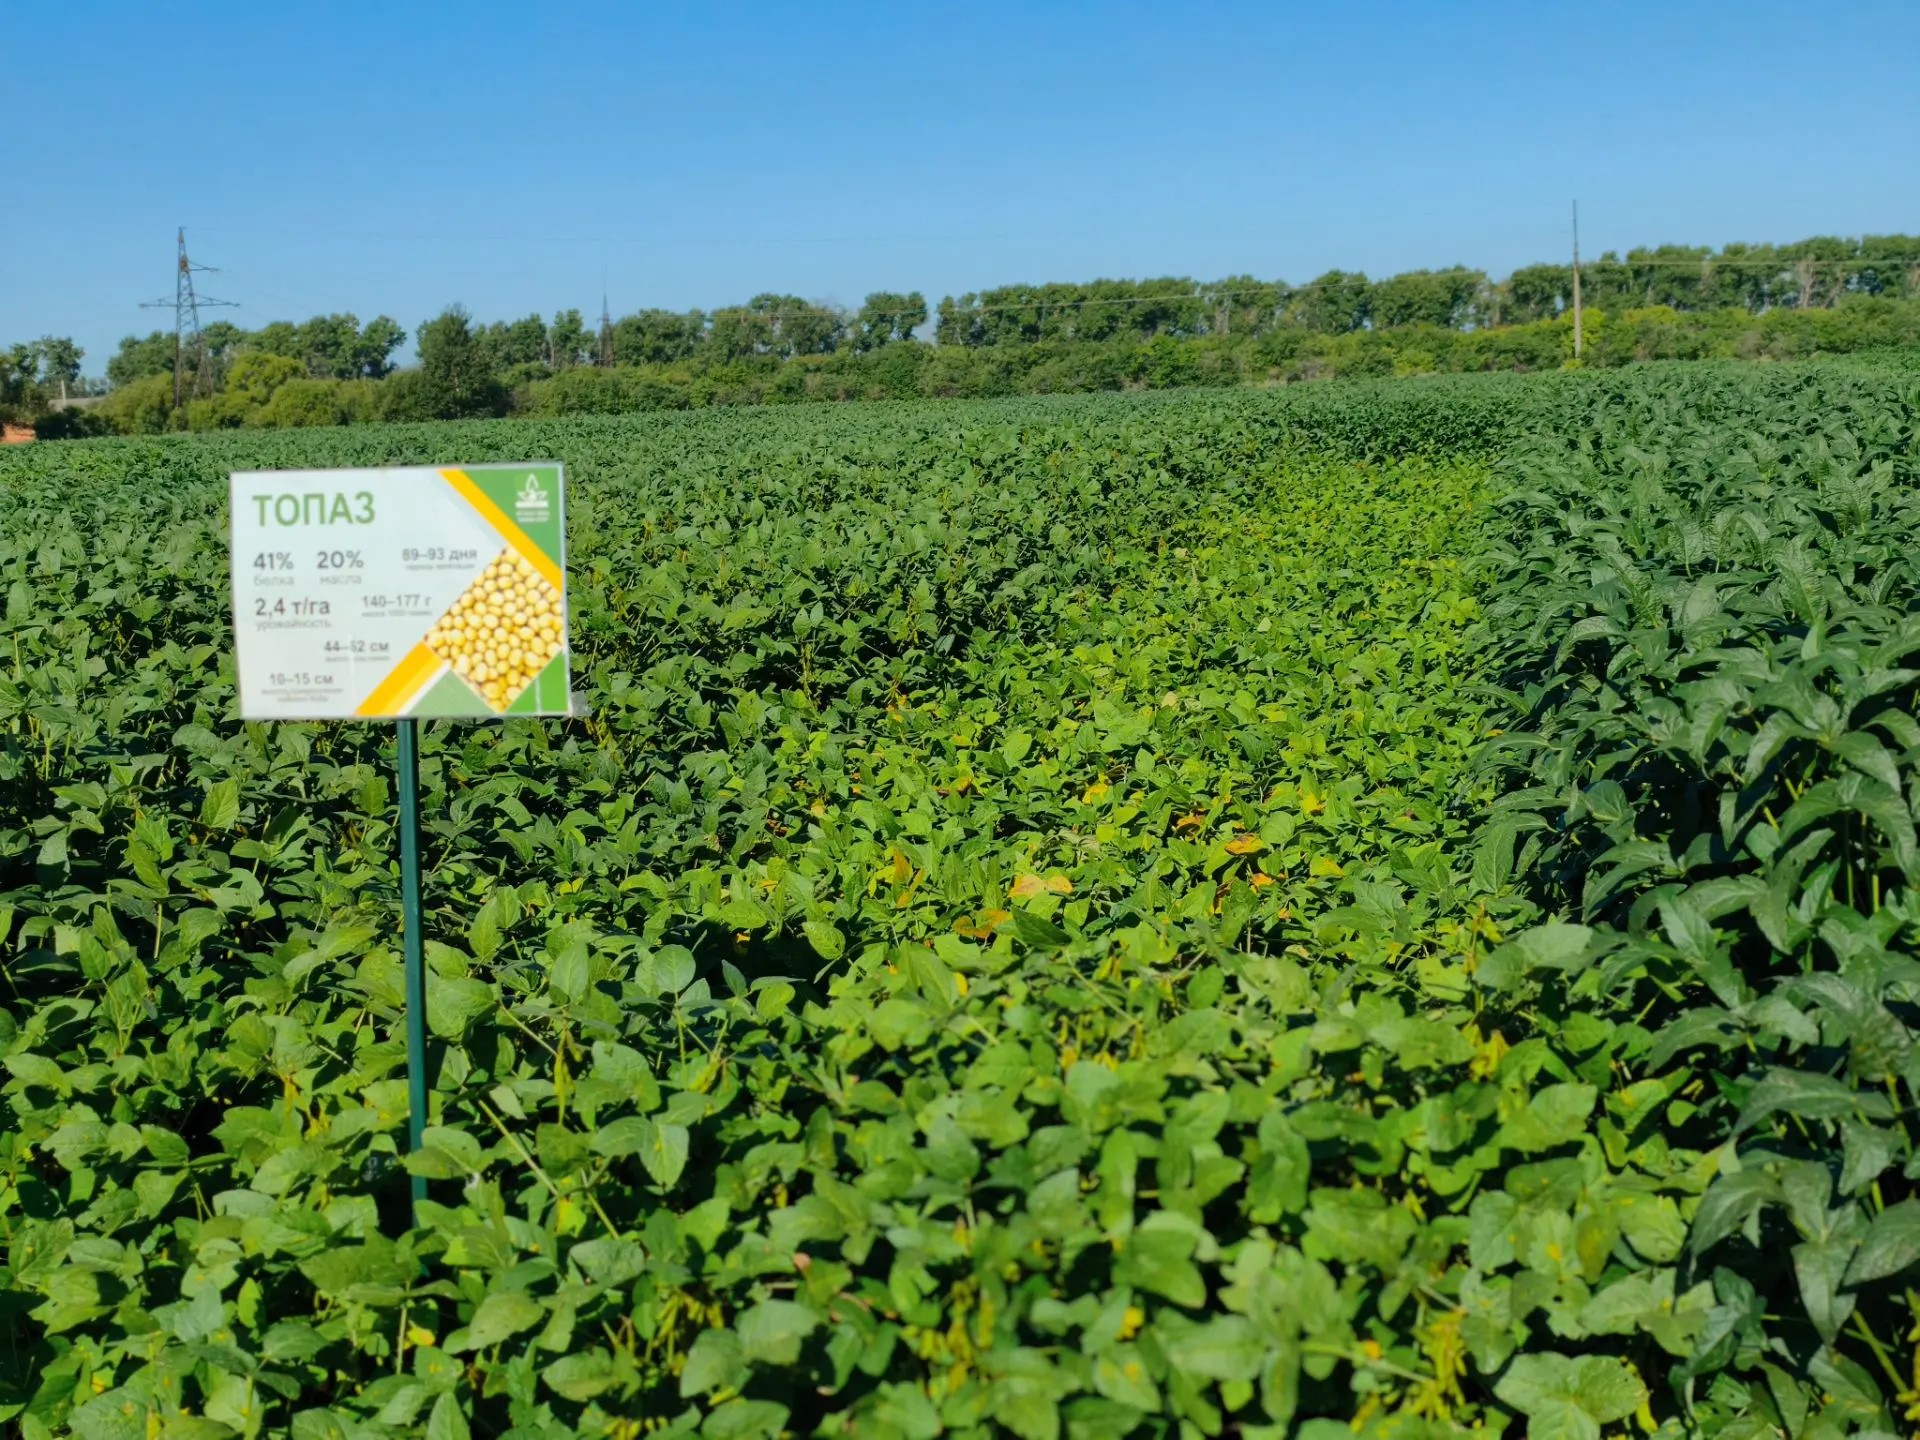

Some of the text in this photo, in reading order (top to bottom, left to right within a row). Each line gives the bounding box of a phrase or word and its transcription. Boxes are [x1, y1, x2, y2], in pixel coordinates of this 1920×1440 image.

[252, 491, 376, 526] ТОПАЗ
[253, 551, 294, 570] 41%
[316, 549, 364, 569] 20%
[449, 549, 478, 561] дня
[319, 574, 362, 585] масла
[254, 596, 330, 619] 2,4 т/га
[369, 641, 390, 652] см
[314, 674, 334, 685] см
